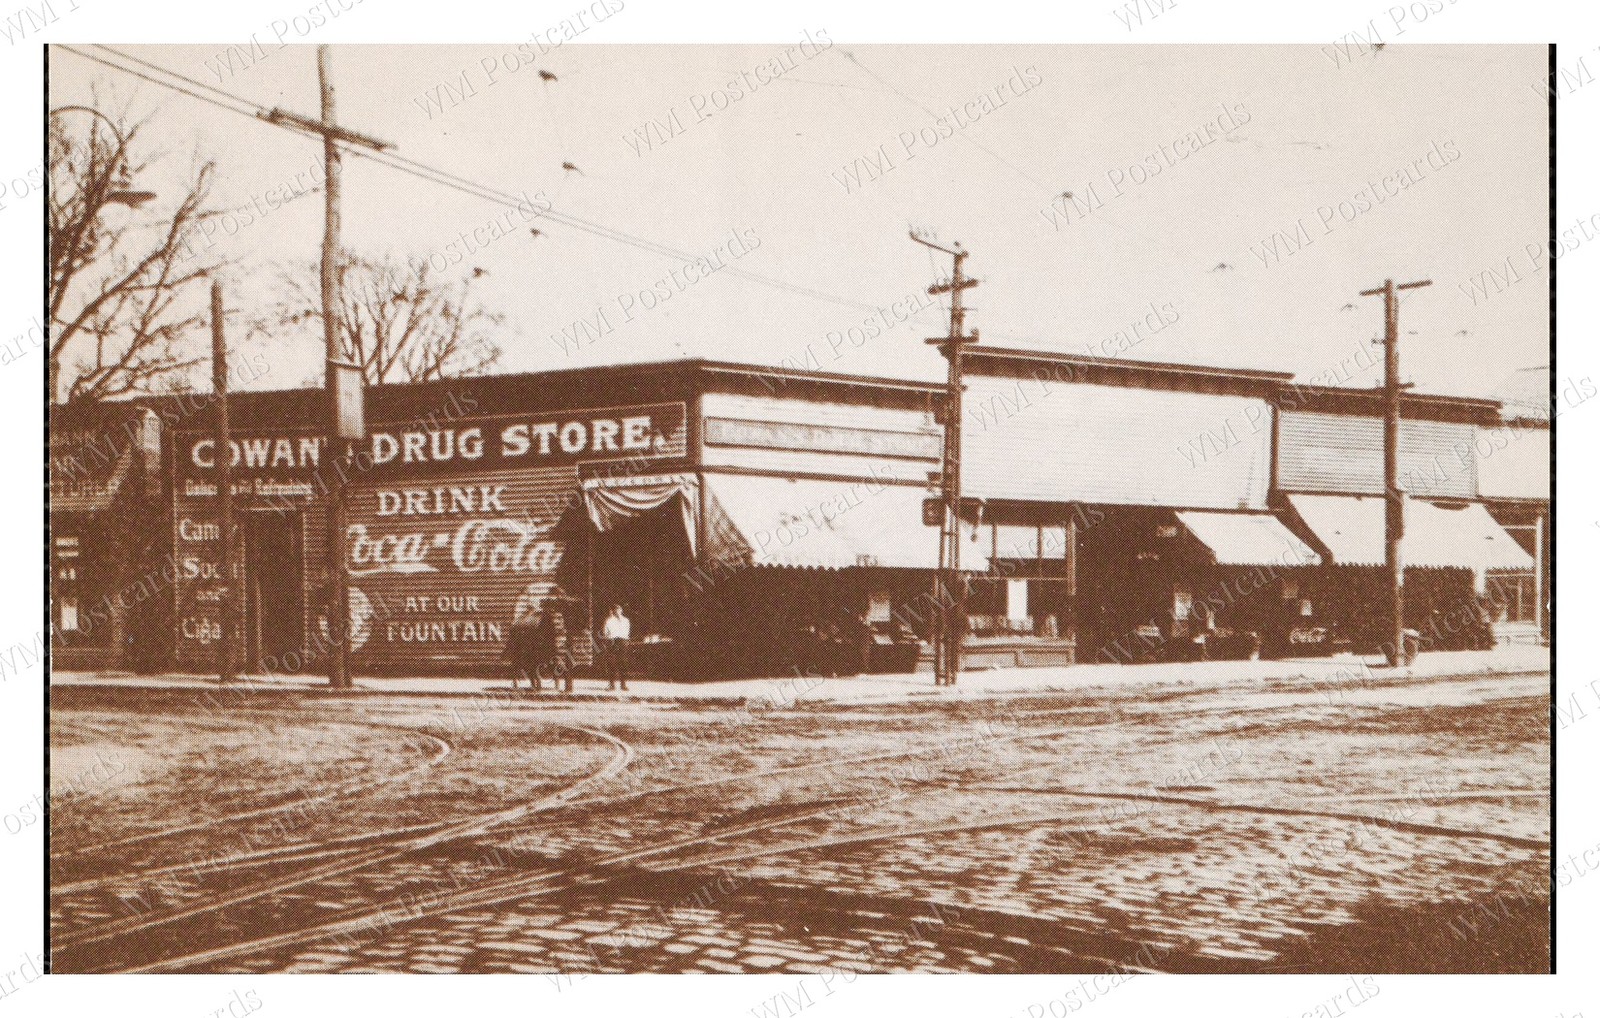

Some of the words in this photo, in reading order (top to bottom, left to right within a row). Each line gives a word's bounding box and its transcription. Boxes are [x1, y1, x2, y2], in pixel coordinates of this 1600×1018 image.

[191, 437, 353, 468] COWAN'
[372, 428, 485, 464] DRUG
[376, 485, 507, 516] DRINK
[404, 597, 430, 612] AT
[437, 596, 480, 612] OUR
[183, 618, 239, 645] Ciga
[387, 621, 502, 641] FOUNTAIN
